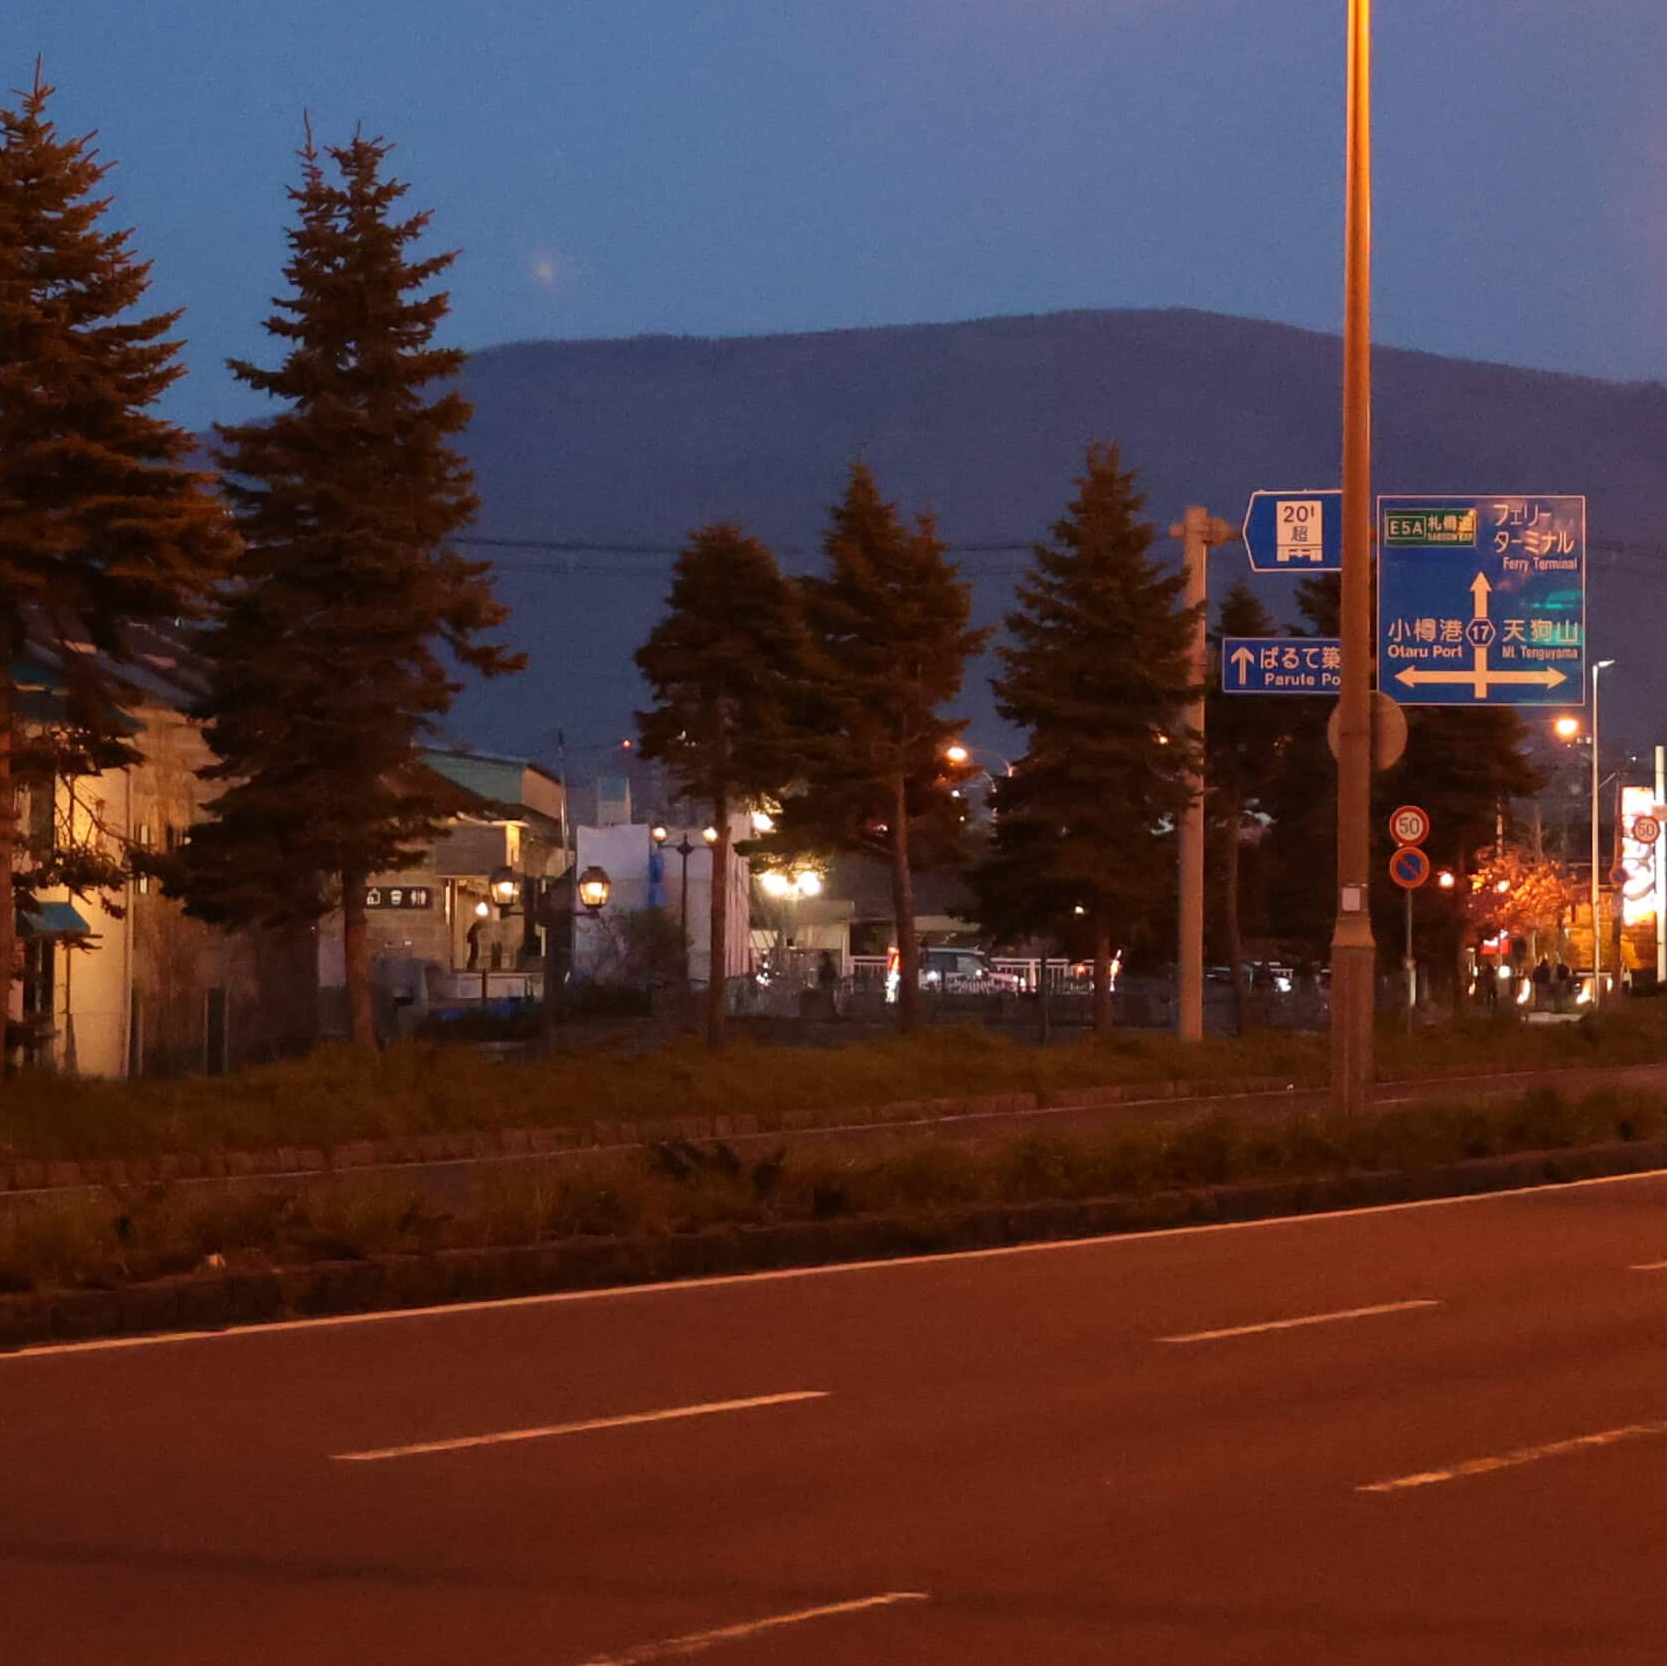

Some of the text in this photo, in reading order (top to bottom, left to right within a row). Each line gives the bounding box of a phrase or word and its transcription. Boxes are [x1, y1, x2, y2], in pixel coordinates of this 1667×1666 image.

[1493, 503, 1552, 527] フェリー
[1389, 521, 1423, 535] E5A
[1493, 530, 1575, 555] ターミナル
[1502, 556, 1578, 572] Ferry Terminal
[1388, 618, 1463, 643] 小樽港
[1472, 625, 1490, 640] 17
[1502, 619, 1578, 643] 天狗山
[1388, 644, 1463, 658] Otaru Port
[1521, 645, 1578, 661] Tenguyama
[1264, 672, 1315, 686] Parute
[1398, 817, 1420, 834] 50
[1637, 822, 1655, 837] 50
